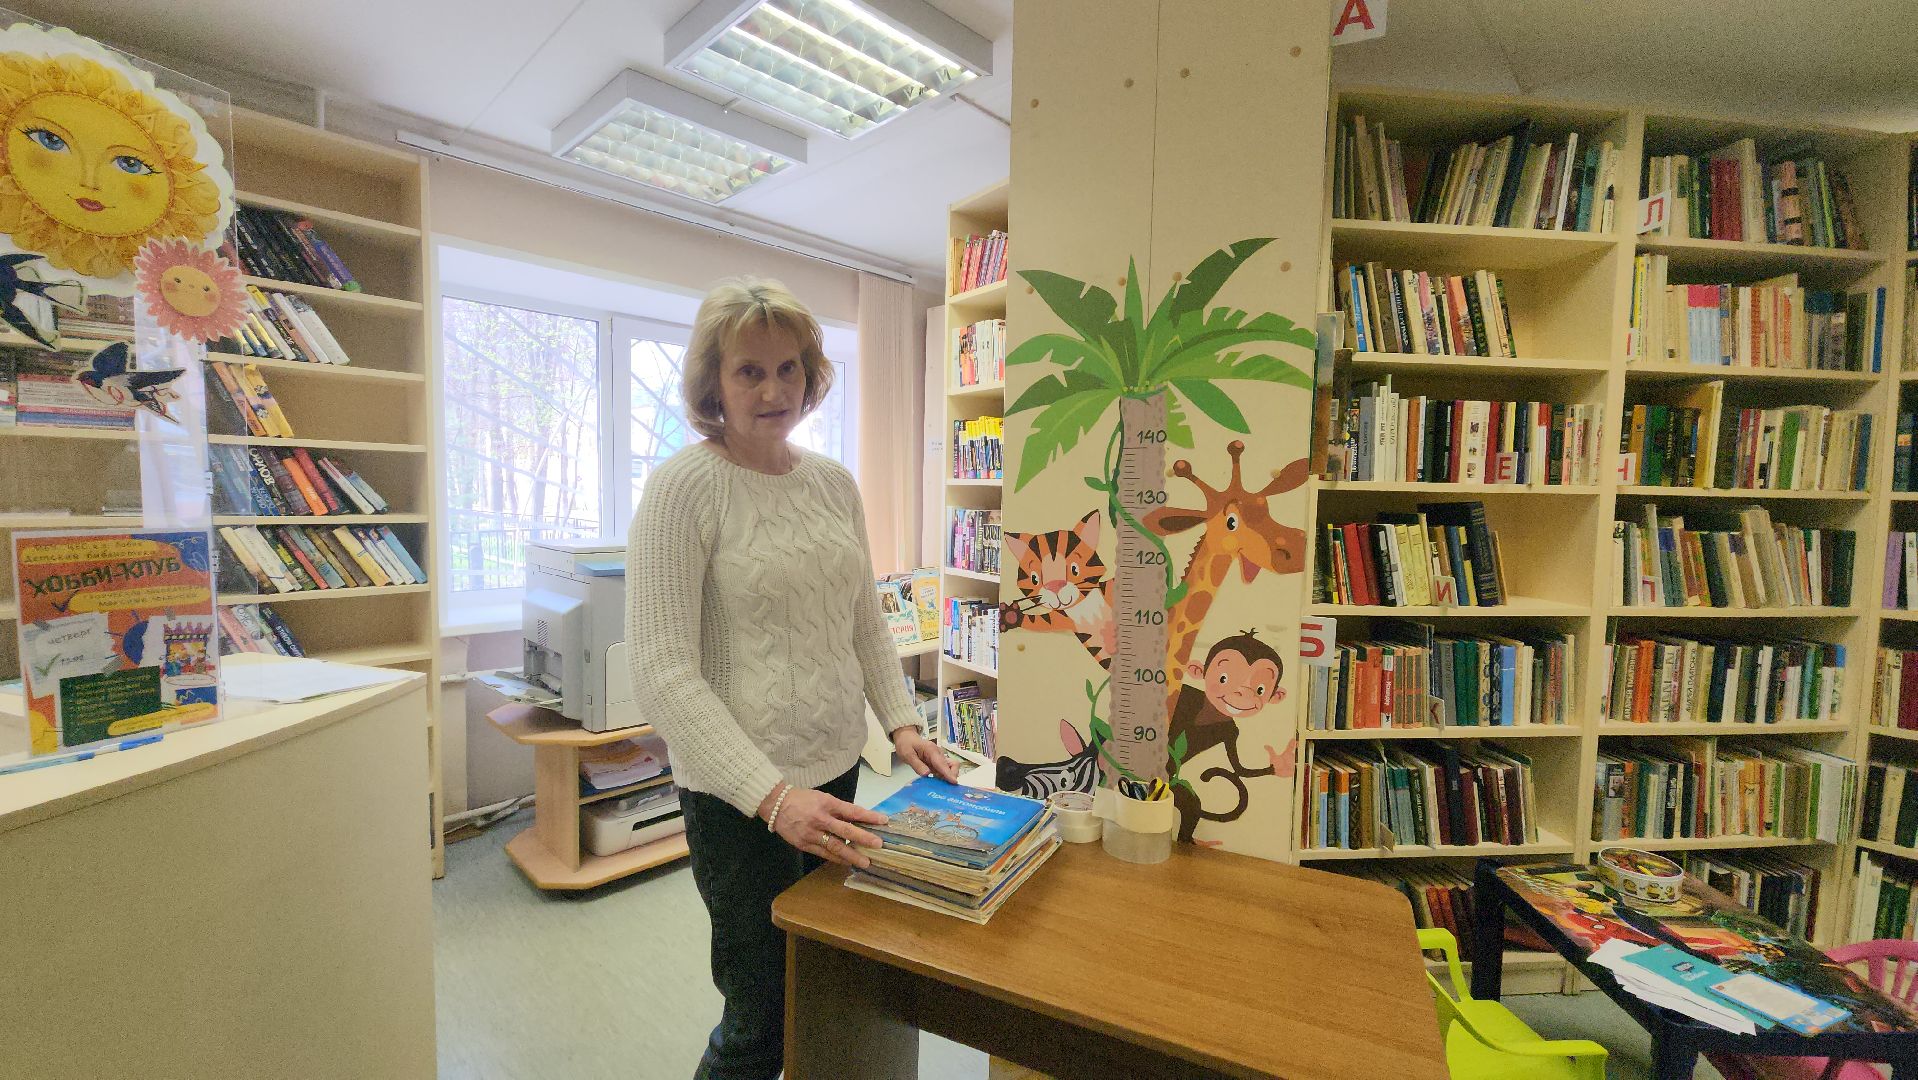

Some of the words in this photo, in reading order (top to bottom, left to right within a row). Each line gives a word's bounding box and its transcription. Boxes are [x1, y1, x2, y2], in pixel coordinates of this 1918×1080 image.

[1333, 0, 1375, 36] А
[1644, 197, 1664, 227] Л
[1137, 430, 1167, 444] 140
[1498, 456, 1512, 480] Е
[1136, 491, 1167, 504] 130
[1136, 552, 1167, 565] 120
[24, 557, 181, 598] ХОББИ-КЛУБ
[1436, 580, 1453, 604] И
[1134, 611, 1164, 624] 110
[1134, 670, 1167, 684] 100
[1133, 727, 1157, 741] 90
[928, 791, 946, 800] Про
